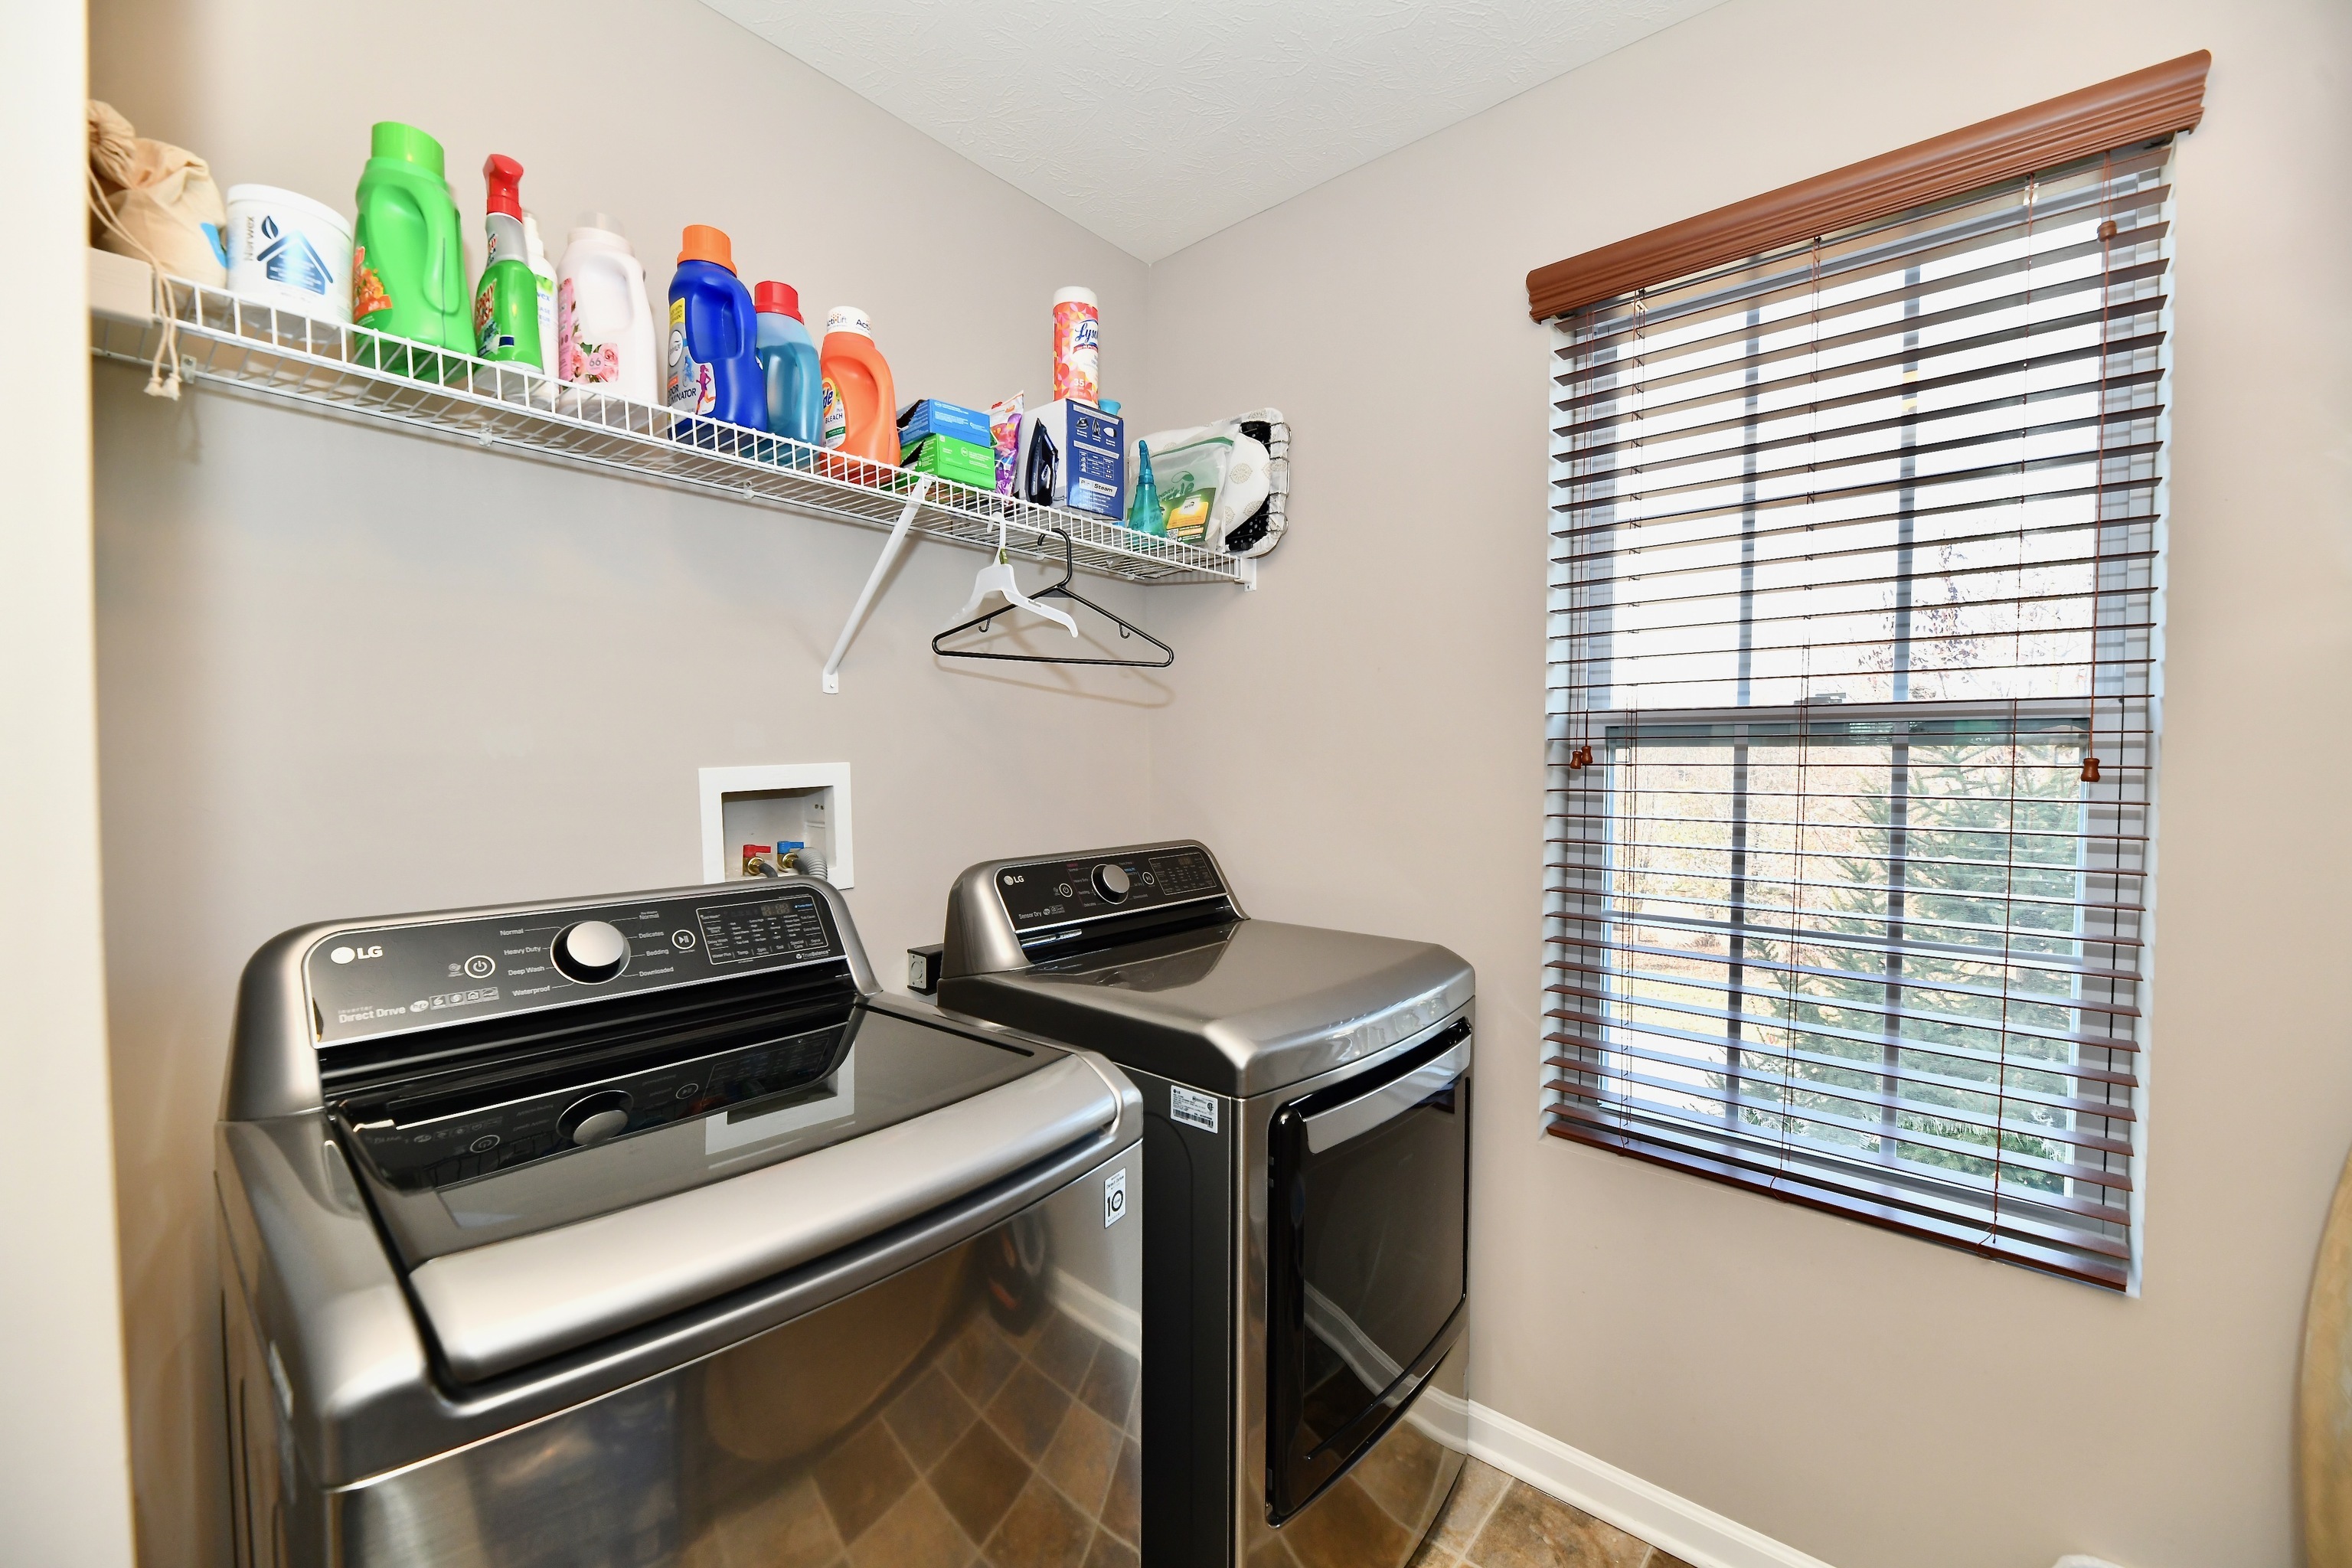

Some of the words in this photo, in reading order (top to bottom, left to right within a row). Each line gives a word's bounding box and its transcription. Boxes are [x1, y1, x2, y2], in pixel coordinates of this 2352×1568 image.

[244, 215, 254, 261] Norwex
[589, 357, 601, 367] 66
[1073, 378, 1085, 387] 35
[822, 388, 834, 409] ide
[825, 413, 843, 424] BLEACH
[1094, 483, 1113, 493] Steam
[1013, 875, 1024, 884] LG
[357, 946, 383, 959] LG
[646, 949, 669, 957] Bedding
[639, 966, 674, 977] Downloaded
[511, 985, 550, 997] Waterproof
[338, 1011, 374, 1024] Direct
[375, 1007, 406, 1018] Drive
[1107, 1190, 1123, 1217] 10
